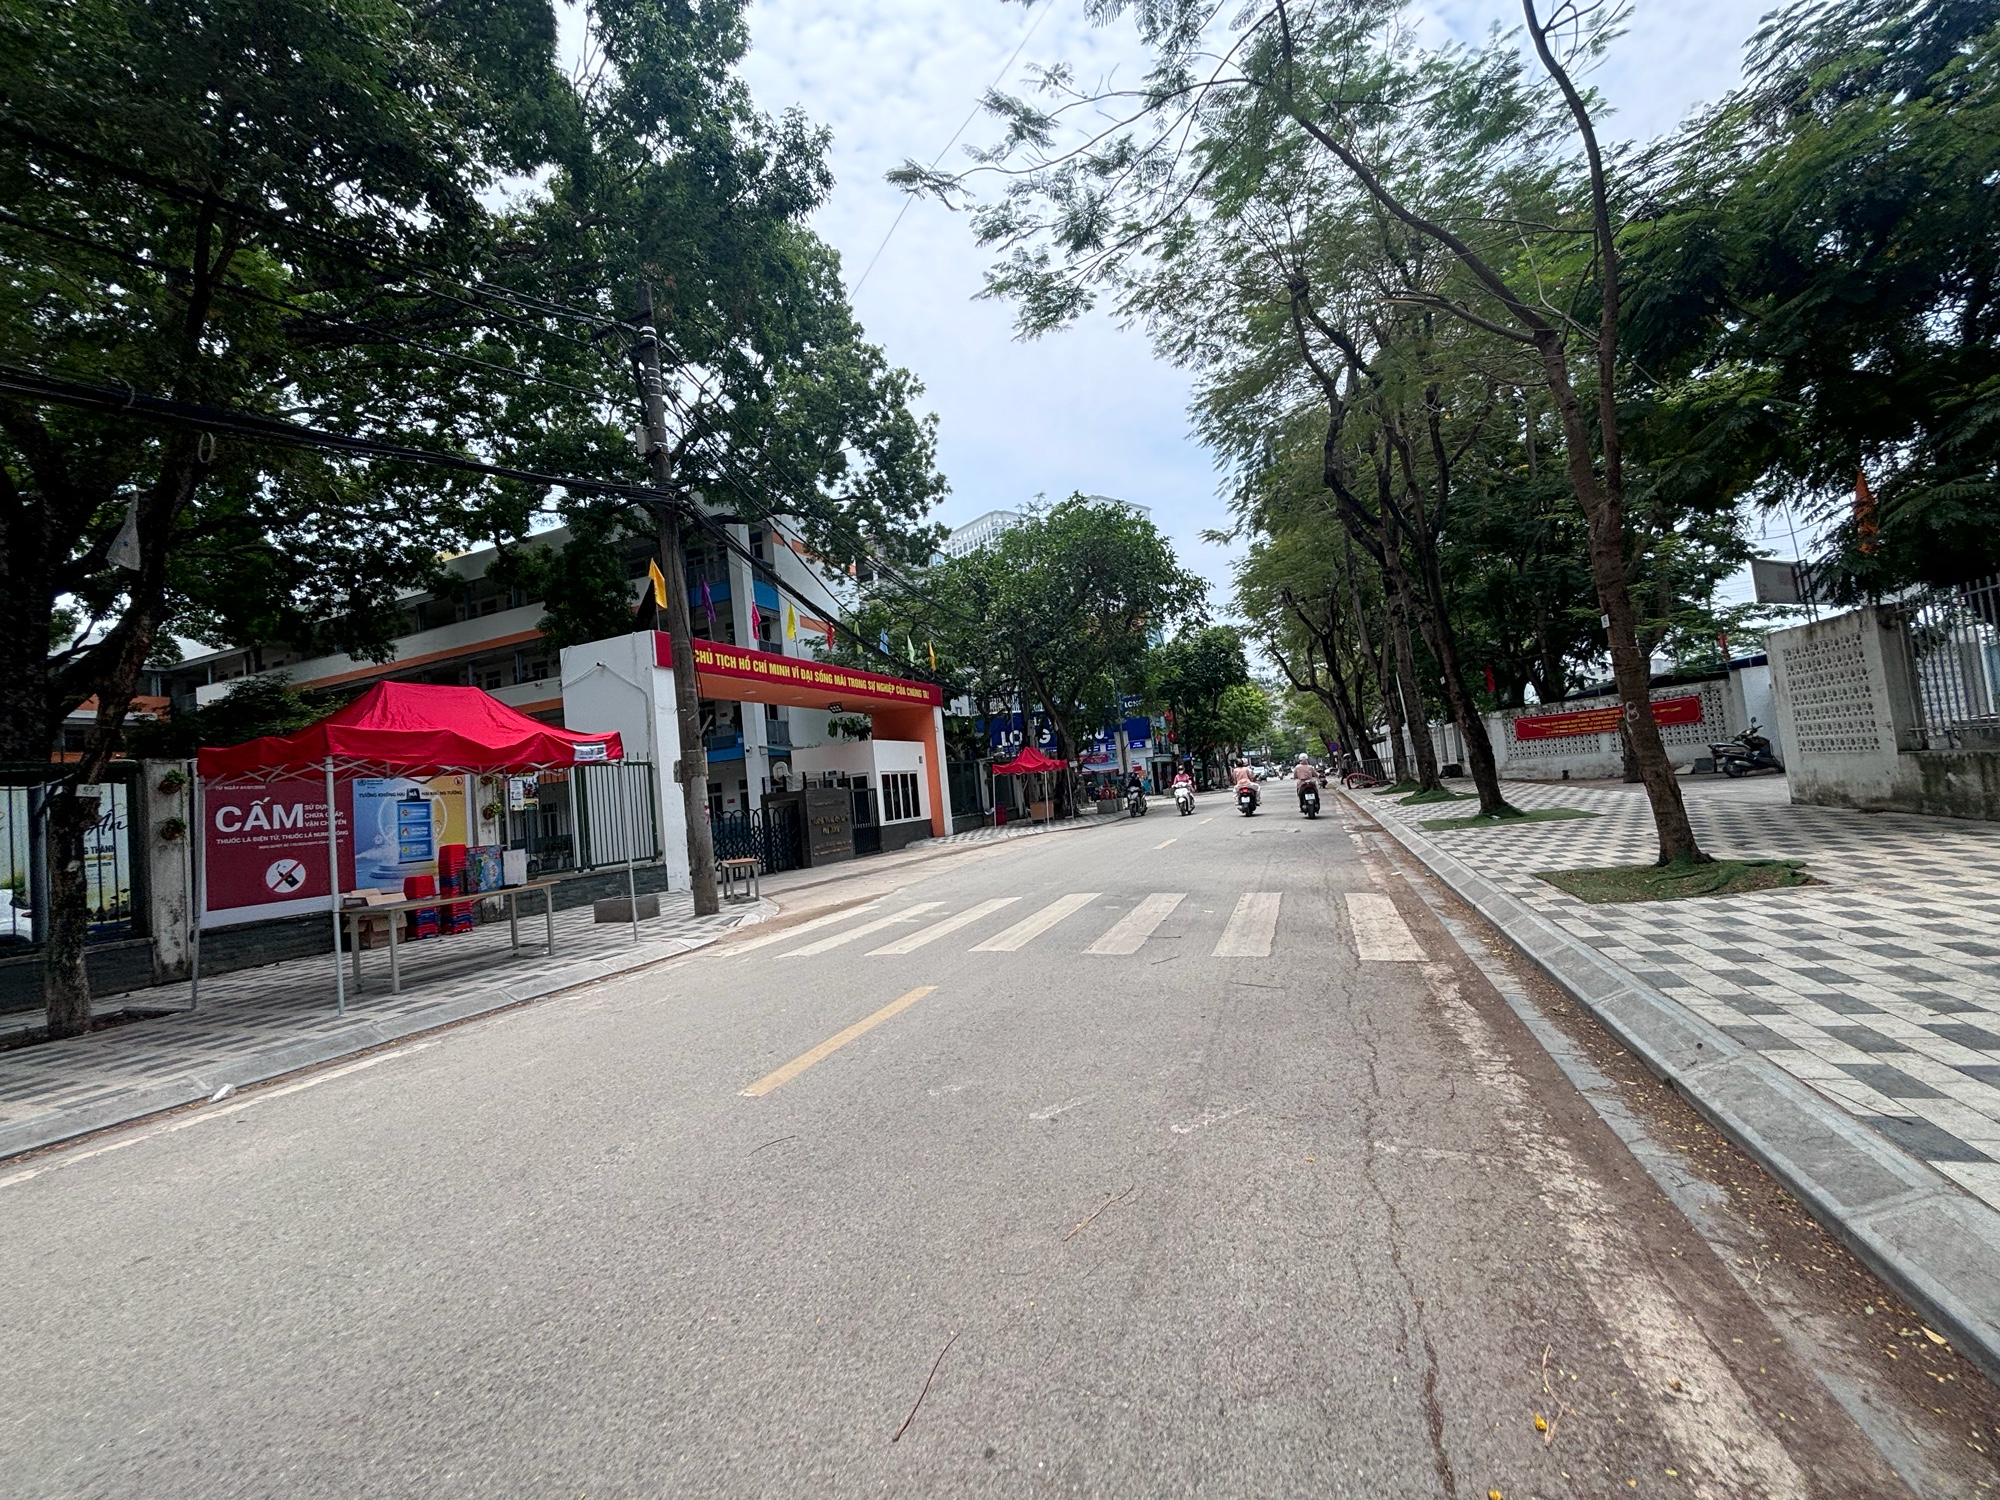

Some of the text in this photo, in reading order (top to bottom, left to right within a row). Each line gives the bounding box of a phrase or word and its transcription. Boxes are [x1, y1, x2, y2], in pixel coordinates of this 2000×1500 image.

[695, 647, 714, 665] CHỦ
[715, 653, 737, 669] TỊCH
[752, 659, 768, 674] CHÍ
[769, 662, 791, 677] MINH
[792, 665, 800, 679] VĨ
[801, 669, 814, 683] ĐẠI
[814, 669, 834, 684] SỐNG
[834, 674, 847, 687] MÃI
[847, 677, 867, 689] TRONG
[867, 680, 876, 693] SỰ
[876, 681, 896, 695] NGHIỆP
[896, 683, 907, 695] CỦA
[906, 687, 923, 698] CHÚNG
[1001, 728, 1051, 746] LOG
[215, 796, 304, 832] CẤM
[242, 835, 252, 843] LÁ
[282, 832, 304, 840] THUỐC
